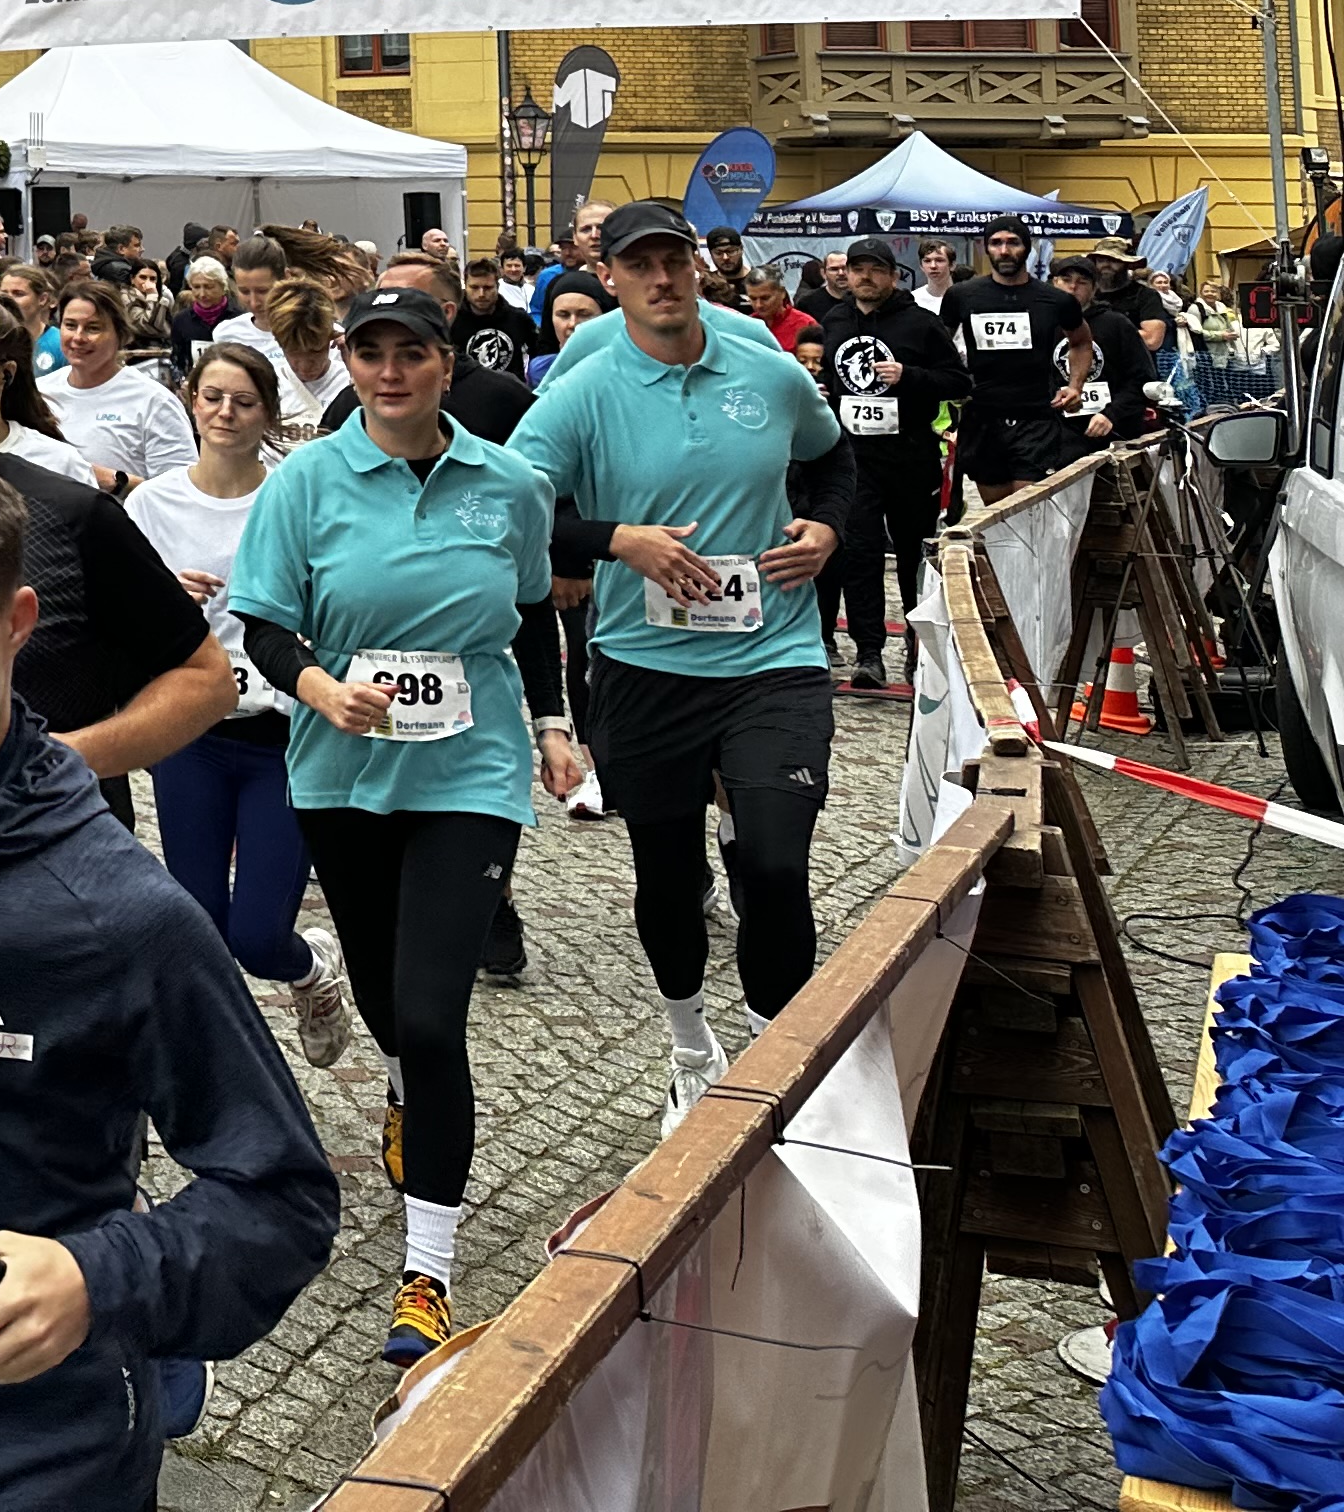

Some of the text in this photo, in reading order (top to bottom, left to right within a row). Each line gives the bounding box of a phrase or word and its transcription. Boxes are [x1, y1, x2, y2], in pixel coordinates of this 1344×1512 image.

[910, 209, 938, 222] BSV
[1021, 211, 1045, 224] e.V.
[1047, 212, 1089, 225] Nauen
[984, 321, 1017, 336] 674
[96, 413, 122, 423] LINDA
[851, 405, 884, 421] 735
[690, 613, 737, 623] Dorfmann
[395, 720, 445, 731] Dorfmann
